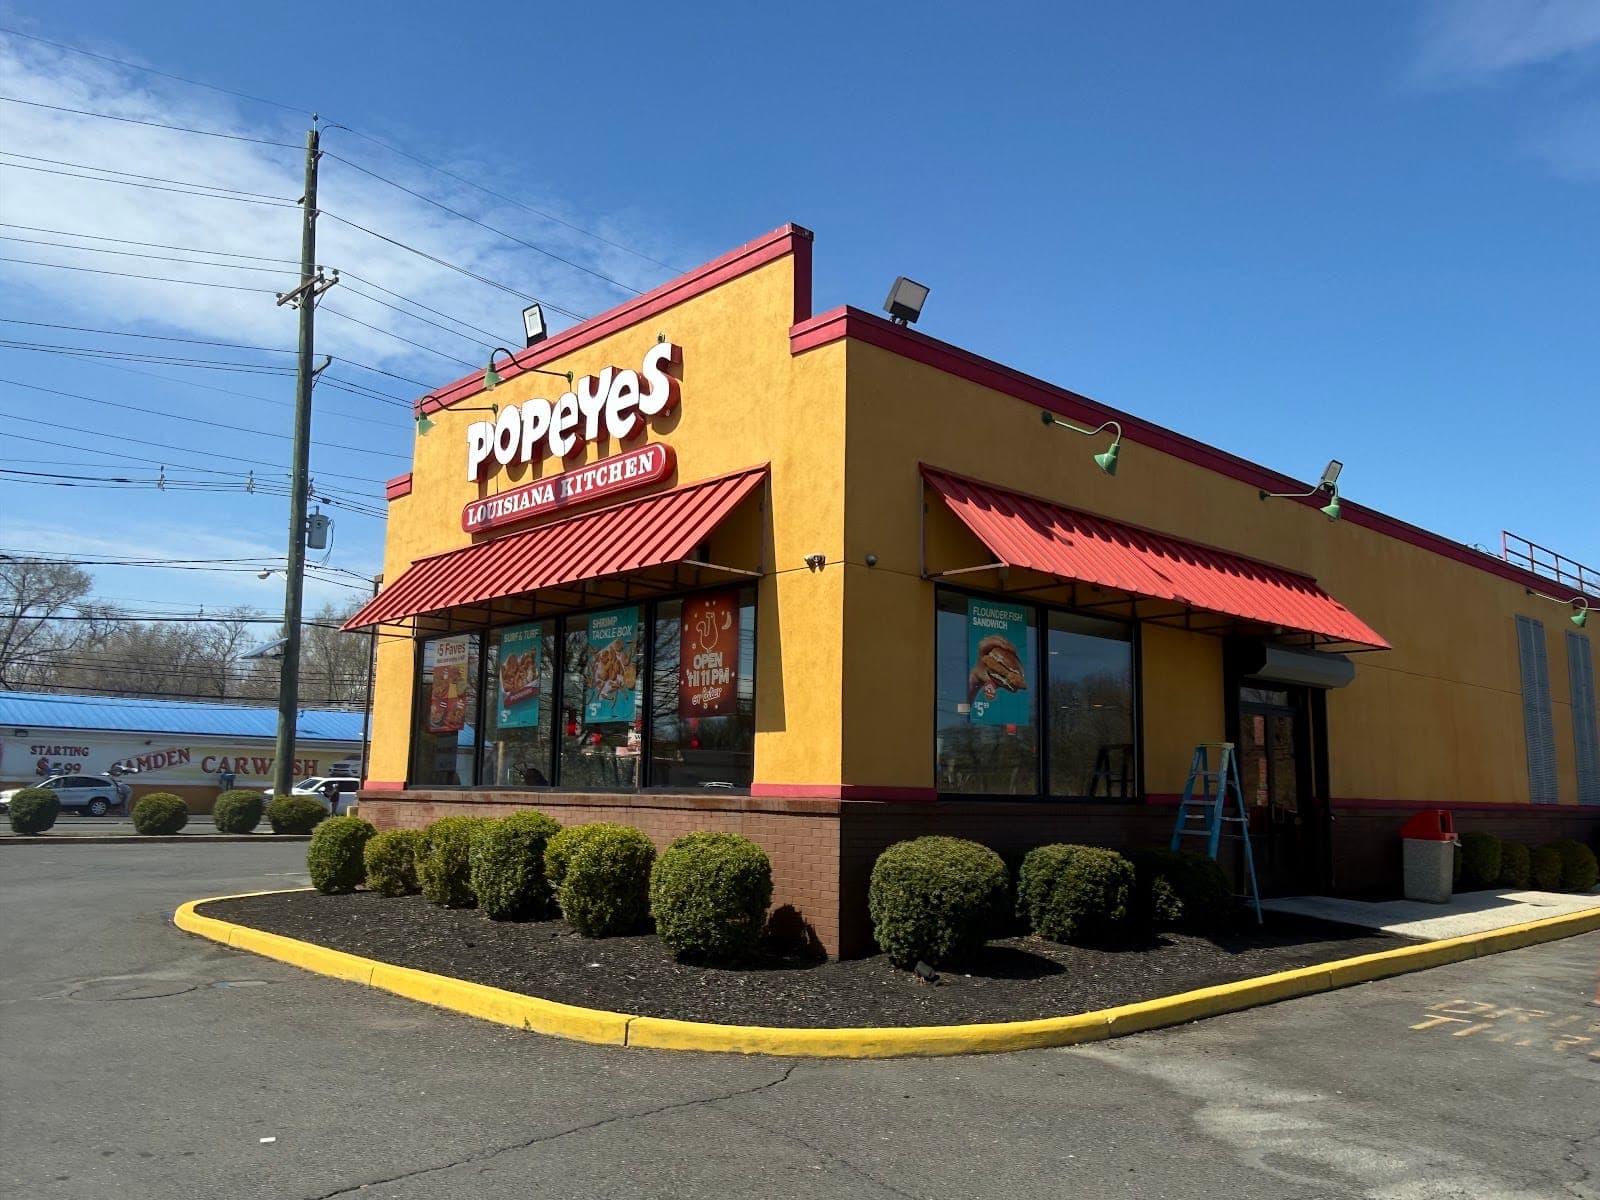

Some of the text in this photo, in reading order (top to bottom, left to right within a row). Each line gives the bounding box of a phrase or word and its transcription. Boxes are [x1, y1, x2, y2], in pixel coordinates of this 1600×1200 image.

[466, 451, 655, 526] LOUISIANA KITCHEN
[592, 616, 618, 629] SHRIMP
[973, 606, 1024, 623] FLOUNDER FISH
[973, 617, 1008, 630] SANDWICH
[592, 625, 632, 640] TACKLE BOX
[693, 652, 723, 670] OPEN
[711, 667, 730, 685] PM
[30, 745, 90, 757] STARTING
[201, 755, 319, 776] CARWSH
